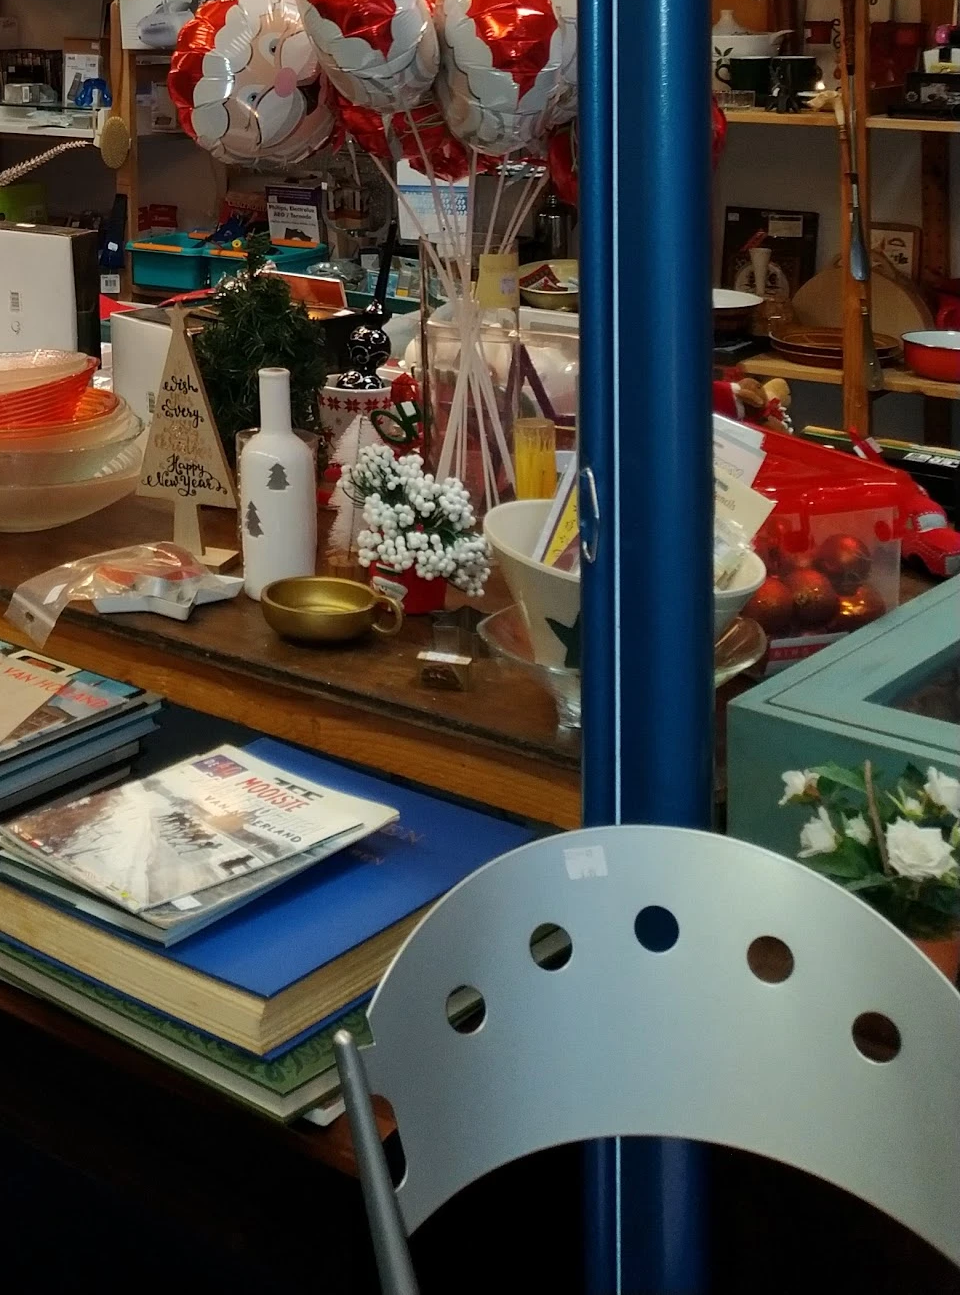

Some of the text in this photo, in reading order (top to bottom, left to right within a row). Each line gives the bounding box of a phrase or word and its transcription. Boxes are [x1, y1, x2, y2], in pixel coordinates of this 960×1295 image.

[166, 453, 212, 479] Happy
[141, 471, 179, 488] New
[4, 667, 37, 683] VAN
[204, 795, 230, 810] VAN
[235, 777, 310, 812] MOOISTE
